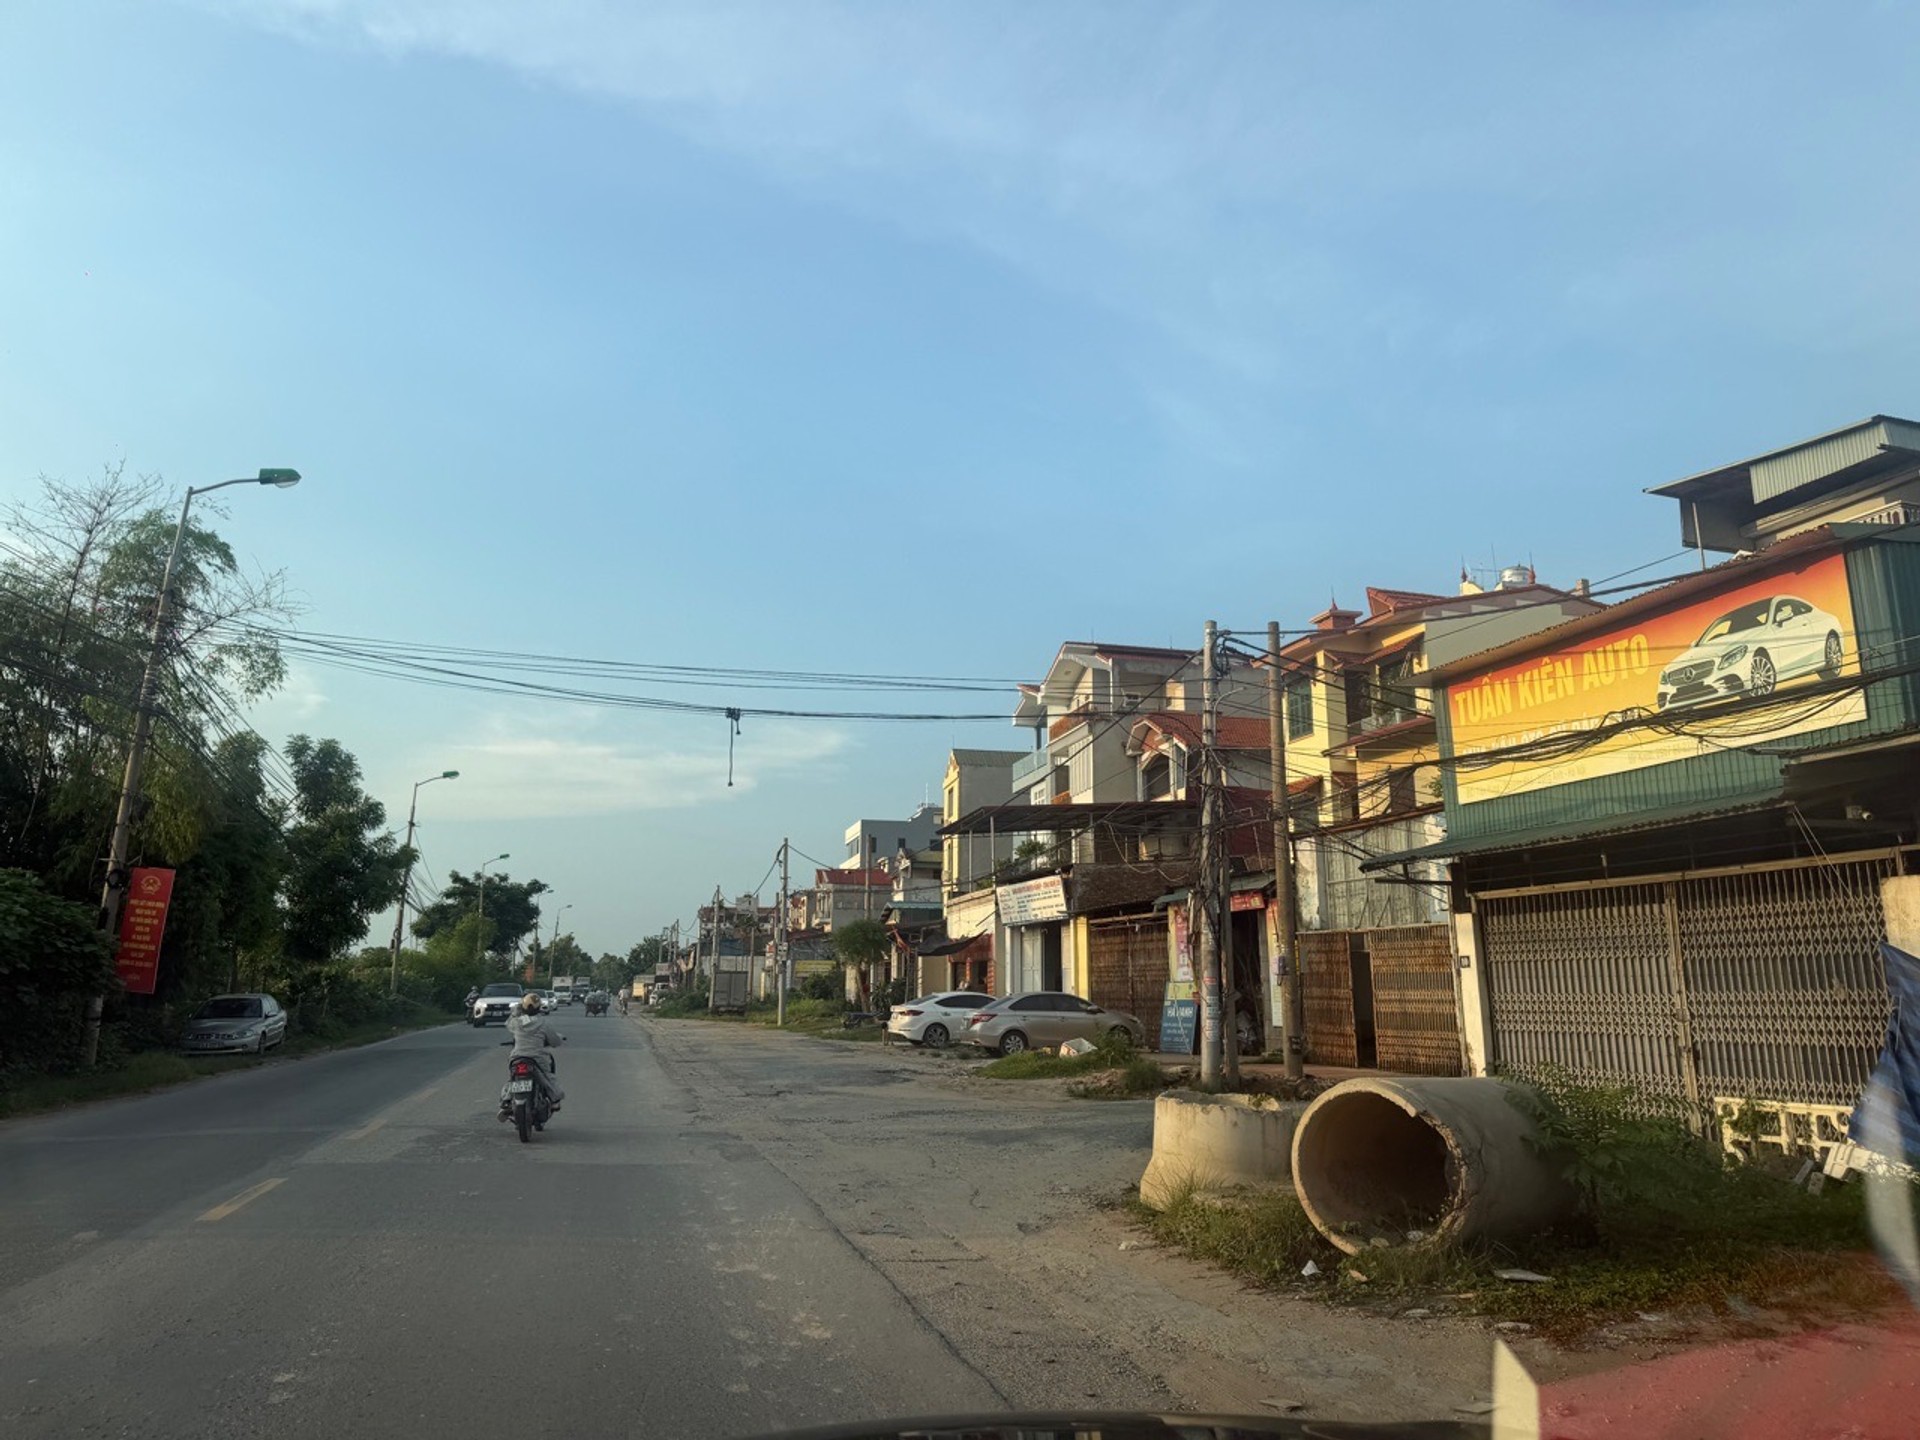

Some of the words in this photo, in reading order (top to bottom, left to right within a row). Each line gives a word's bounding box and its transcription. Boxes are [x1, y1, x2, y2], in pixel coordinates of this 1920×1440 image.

[1454, 673, 1513, 726] TUẤN
[1516, 657, 1575, 710] KIÊN
[1582, 633, 1650, 692] AUTO
